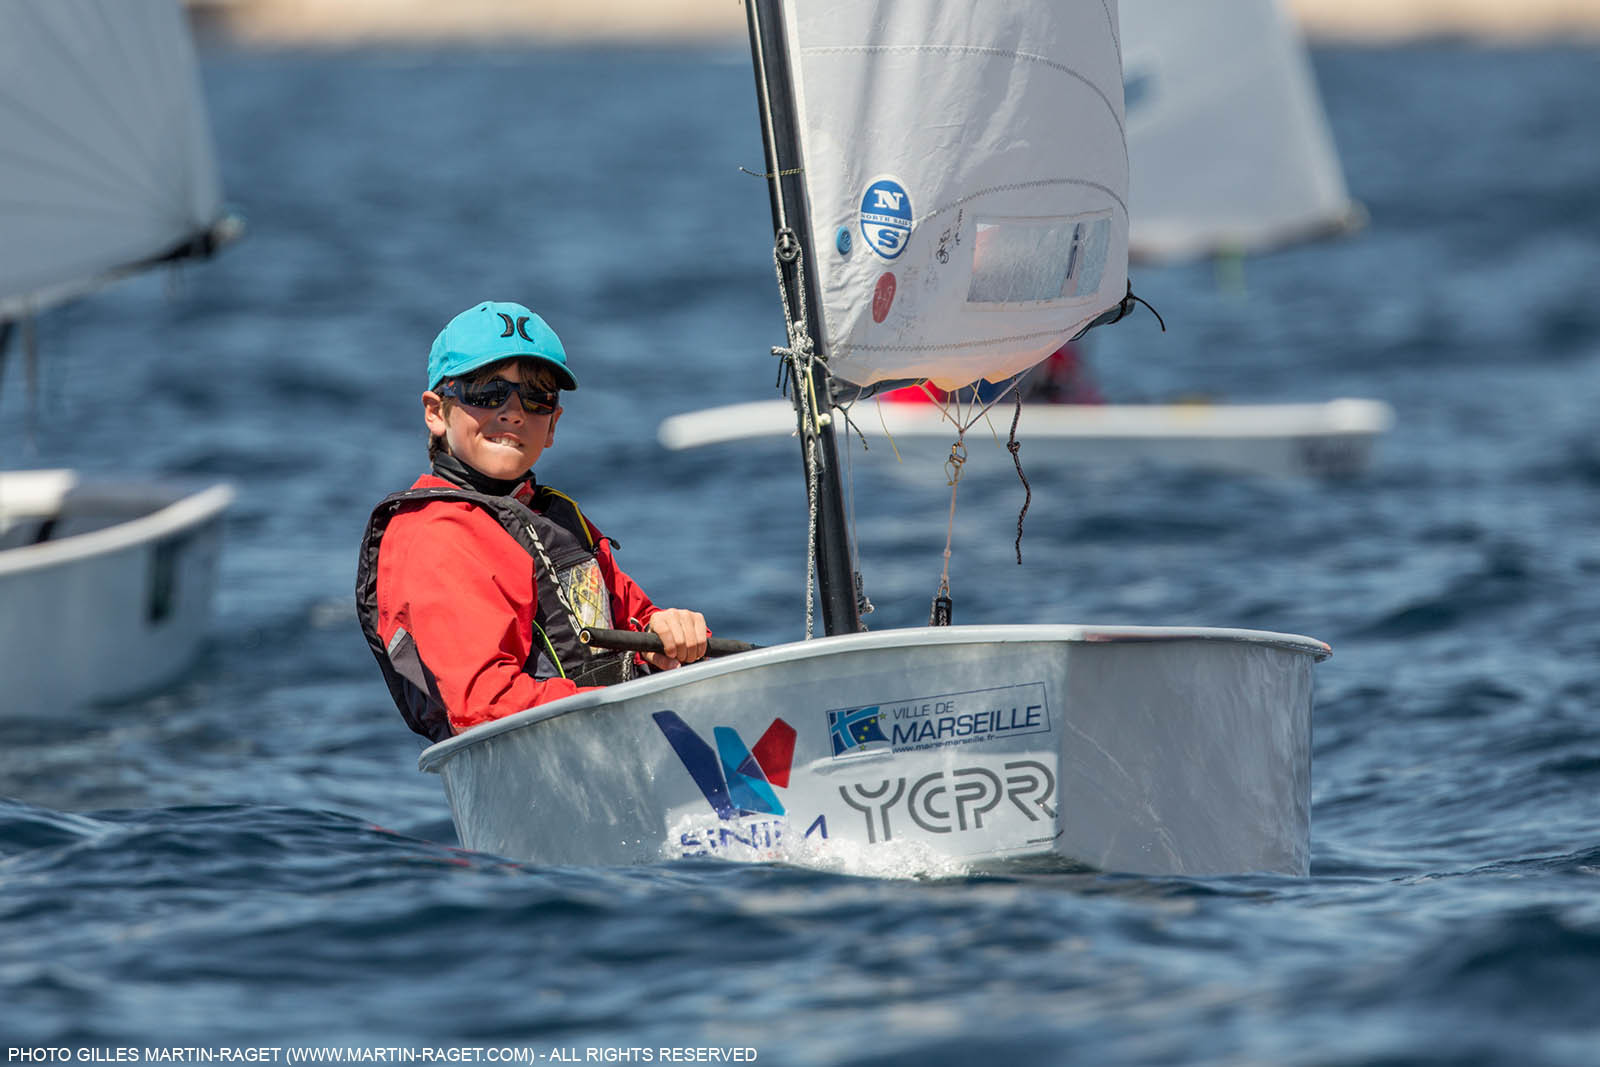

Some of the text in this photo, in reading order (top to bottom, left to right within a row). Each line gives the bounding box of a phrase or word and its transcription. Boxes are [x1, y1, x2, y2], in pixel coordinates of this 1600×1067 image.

[874, 189, 903, 210] N
[861, 212, 890, 222] NORTH
[878, 229, 900, 248] S
[893, 700, 955, 720] VILLE DE
[892, 705, 1042, 745] MARSEILLE
[839, 760, 1057, 844] YCPR
